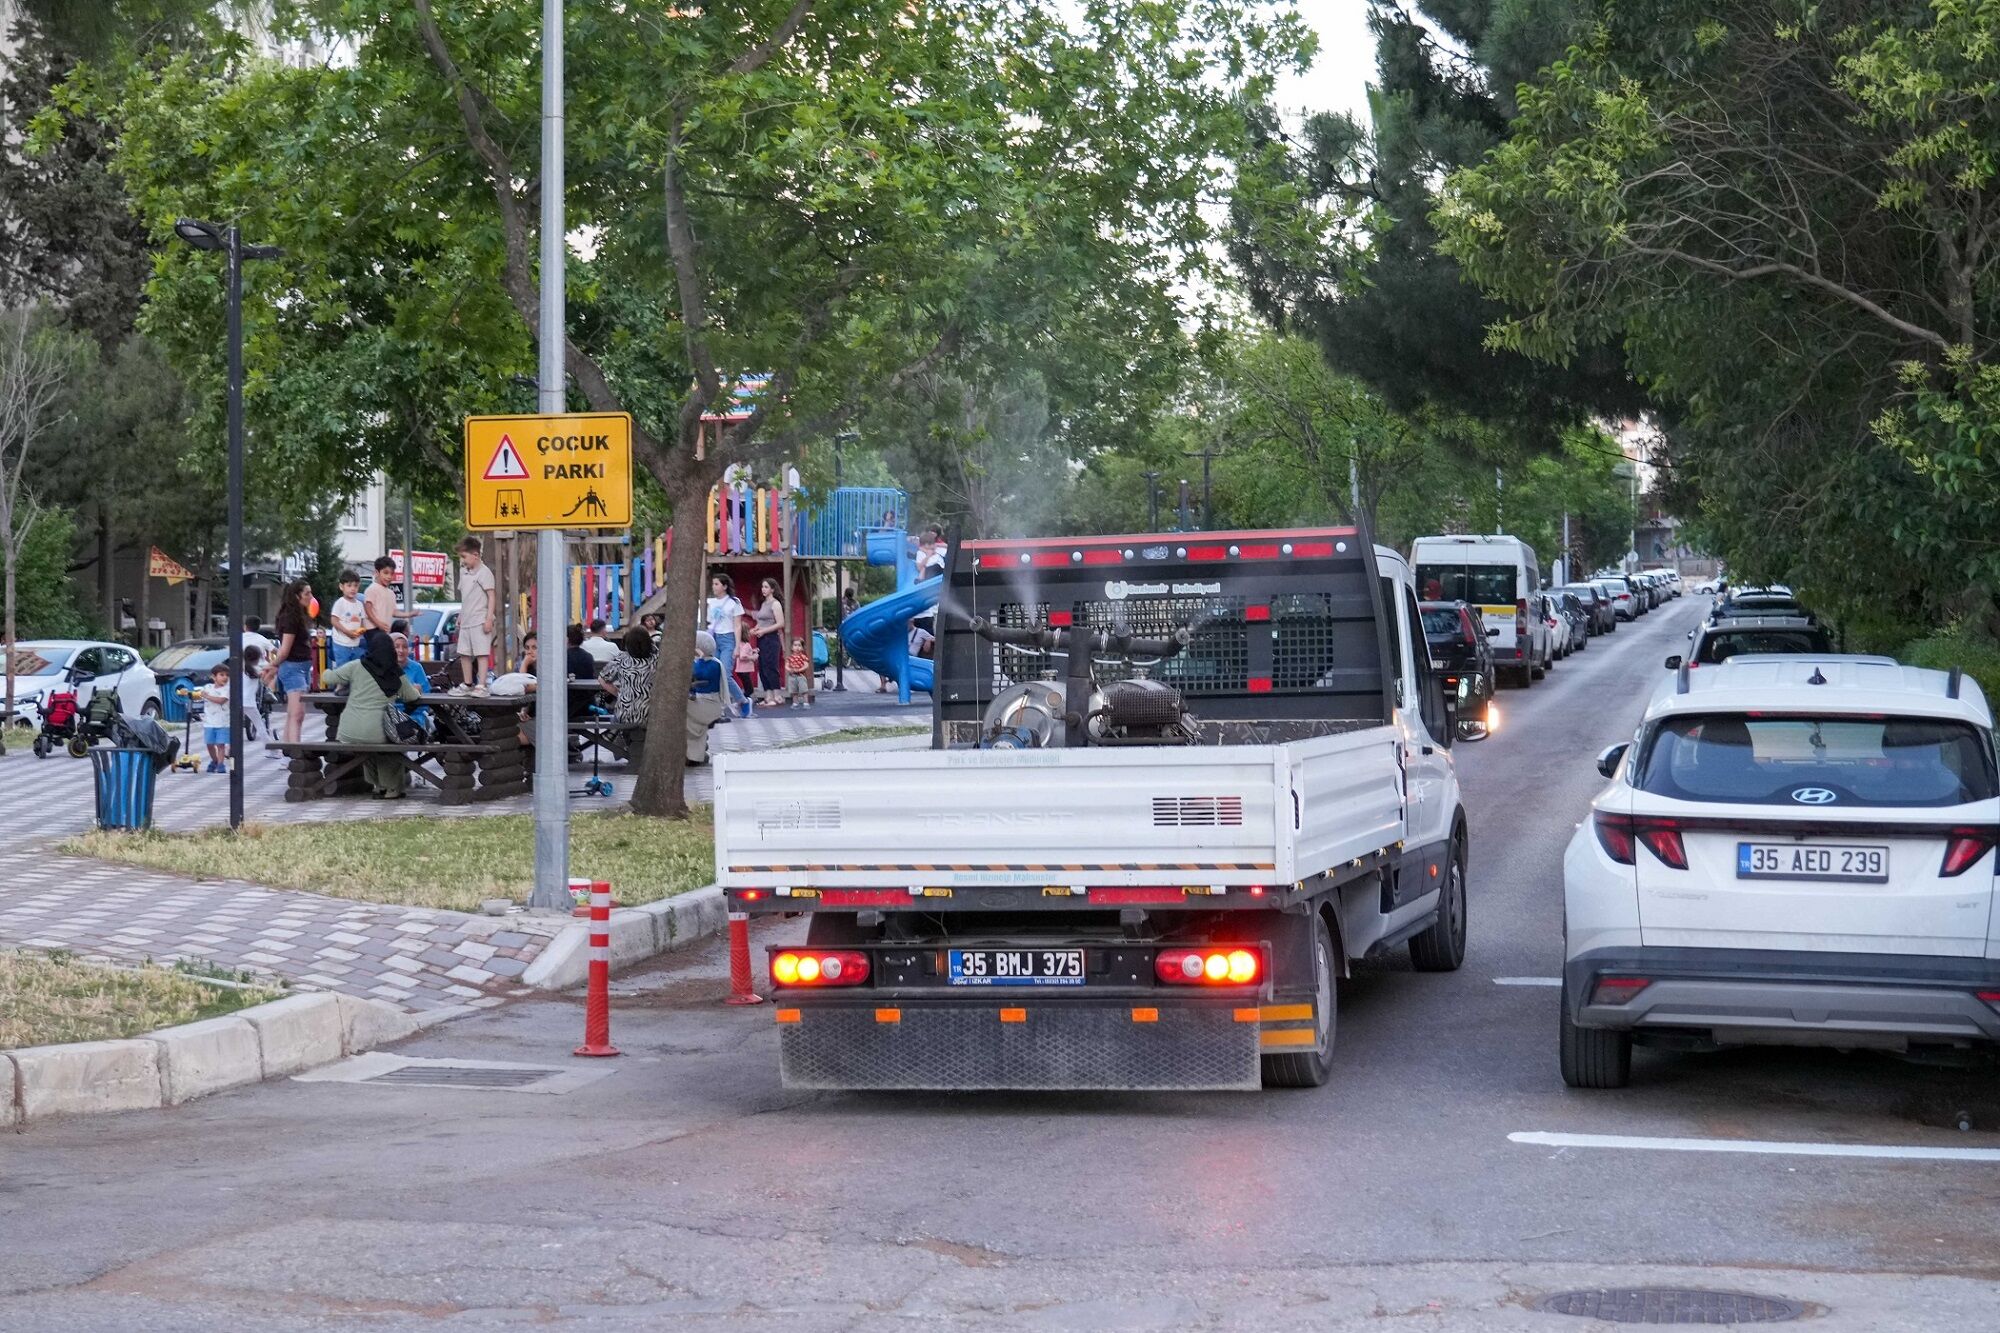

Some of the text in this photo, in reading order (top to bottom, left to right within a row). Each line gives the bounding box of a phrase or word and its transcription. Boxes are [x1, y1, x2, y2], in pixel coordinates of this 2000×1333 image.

[537, 435, 610, 456] ÇOCUK
[544, 463, 604, 479] PARKI
[917, 813, 1074, 827] TRANSIT
[1753, 849, 1779, 871] 35
[1792, 850, 1831, 872] AED
[1841, 851, 1881, 873] 239
[962, 952, 987, 976] 35
[996, 952, 1033, 976] BMJ
[1043, 952, 1080, 976] 375
